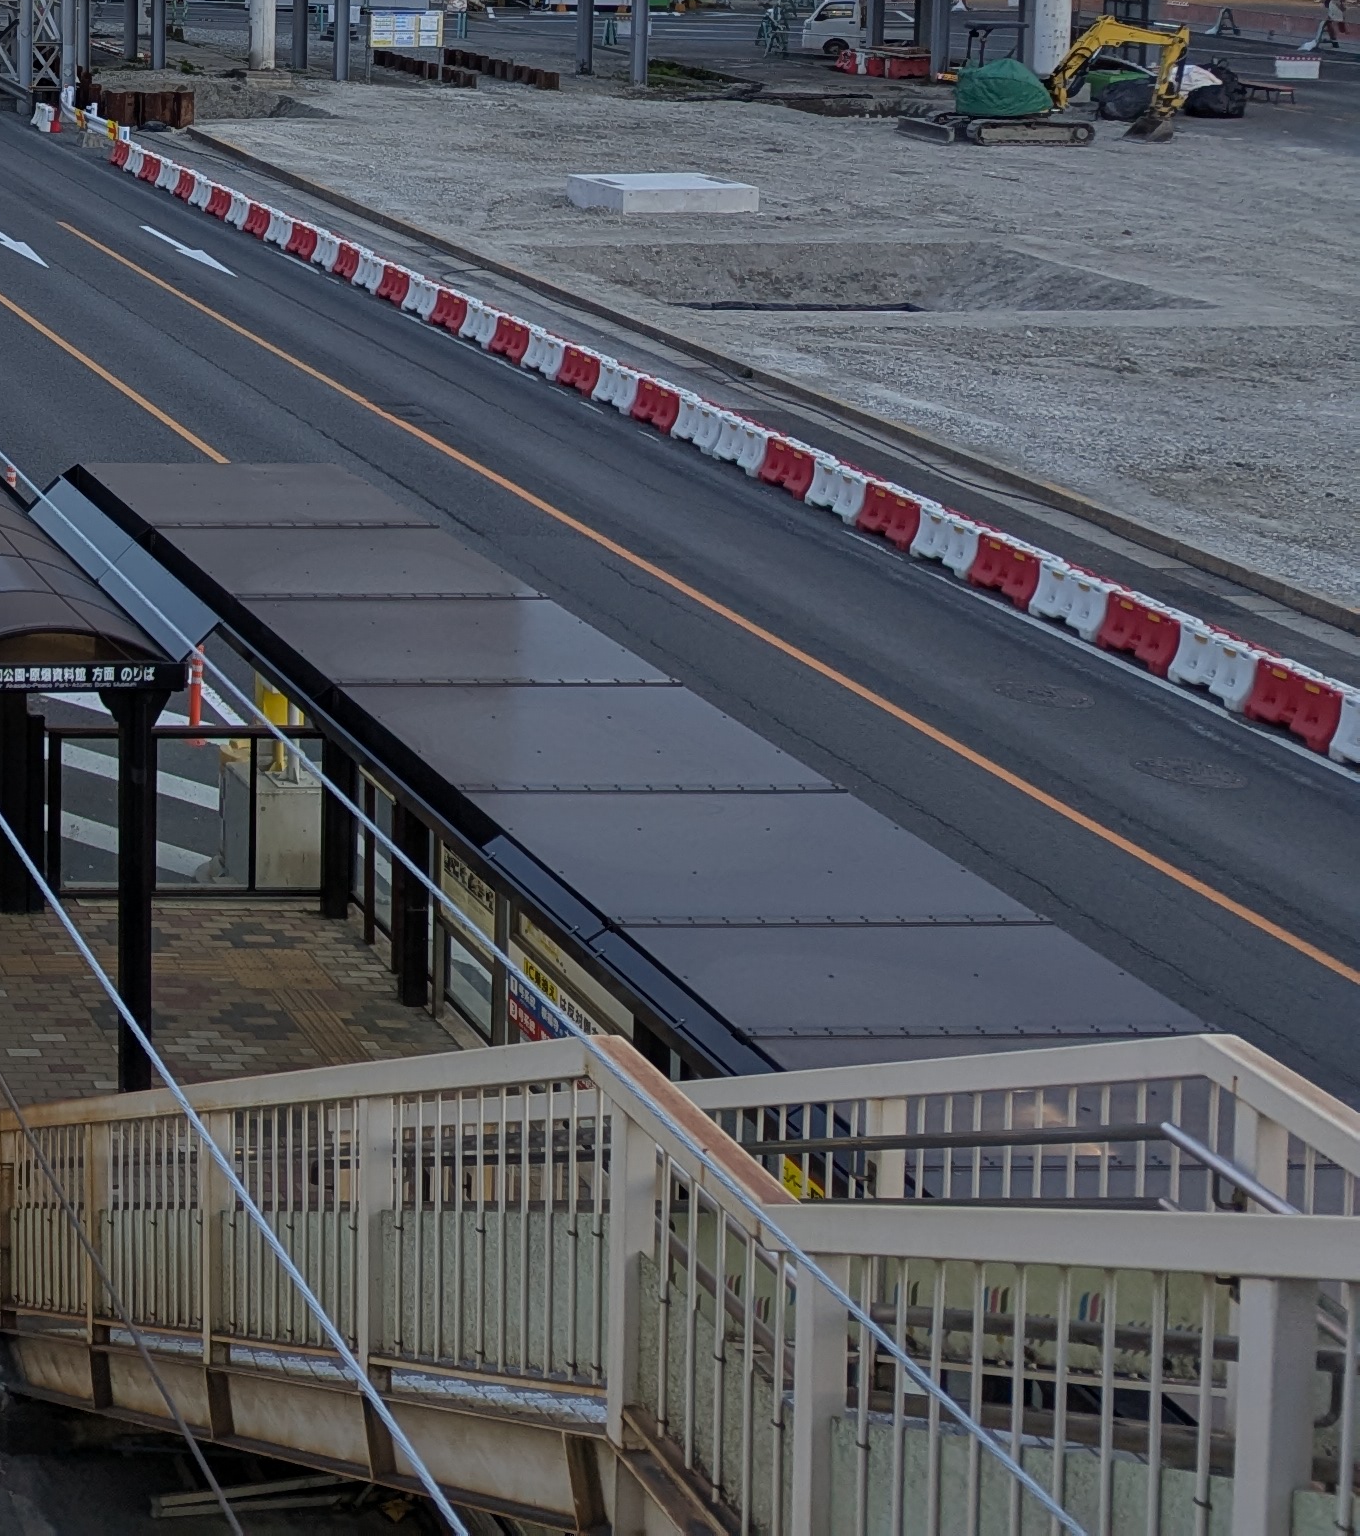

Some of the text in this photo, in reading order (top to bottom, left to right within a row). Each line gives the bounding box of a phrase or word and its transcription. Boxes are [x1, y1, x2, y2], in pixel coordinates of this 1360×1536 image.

[92, 666, 116, 682] 方面
[120, 666, 155, 682] のりば
